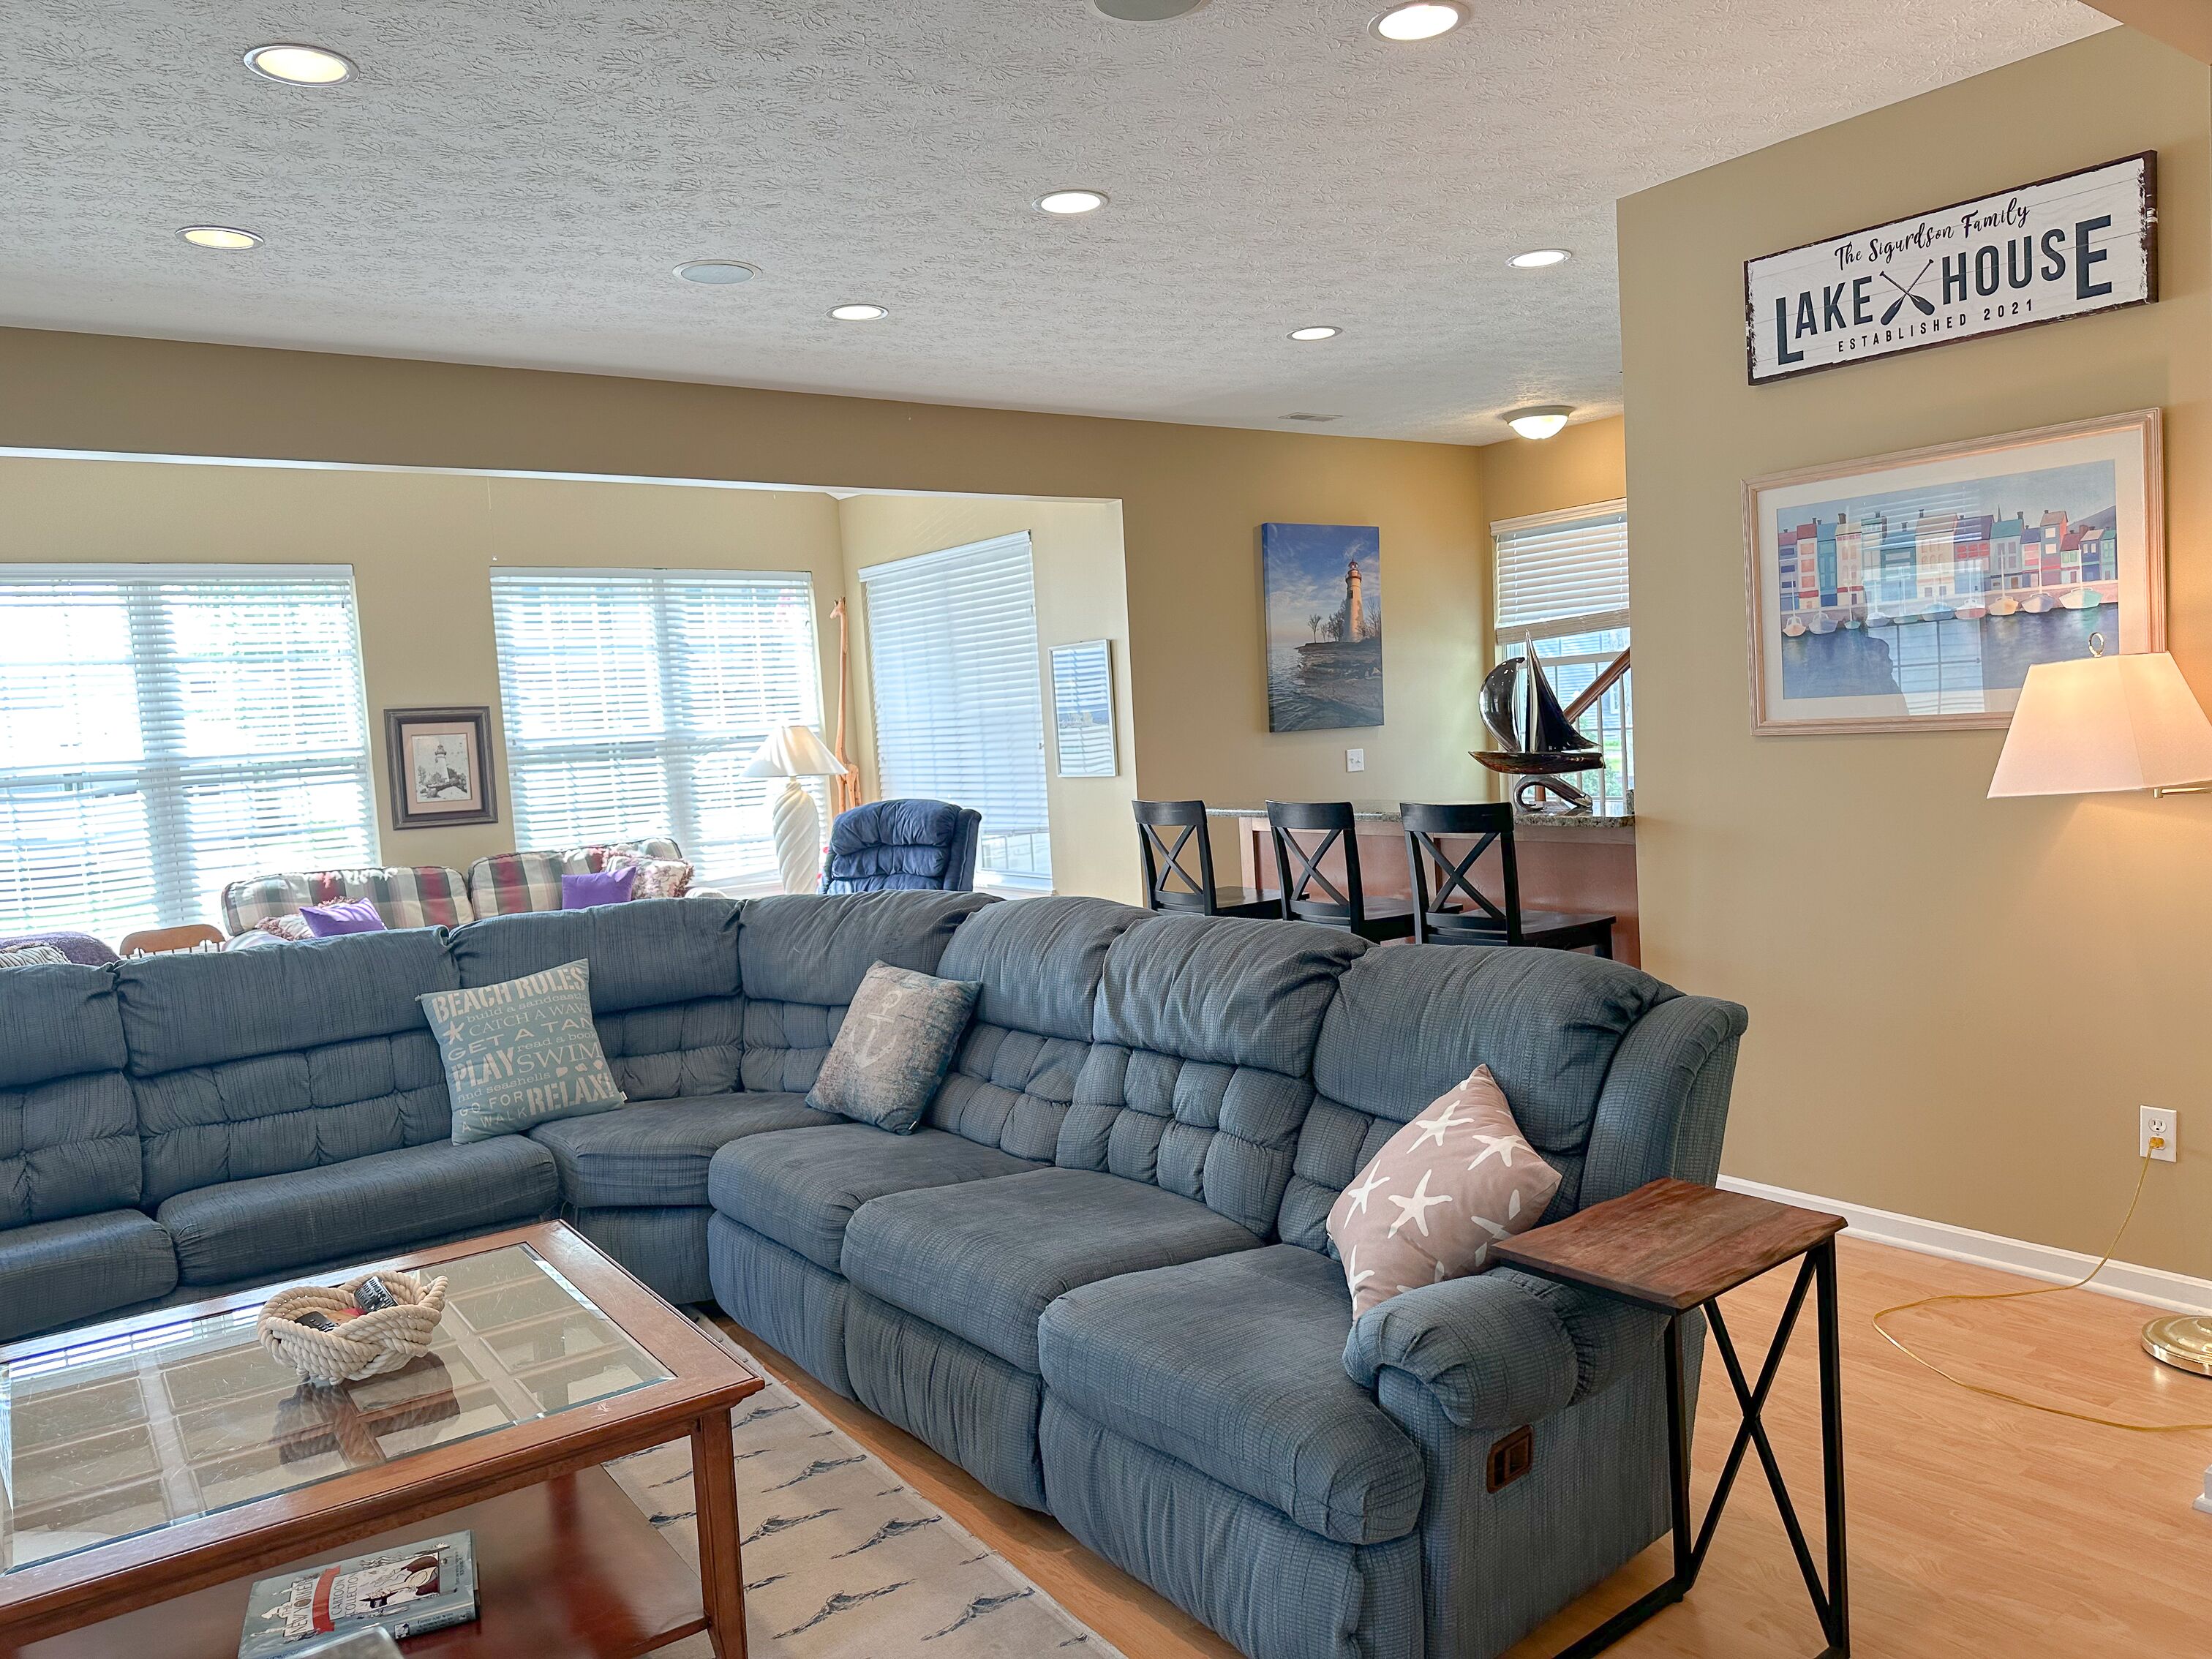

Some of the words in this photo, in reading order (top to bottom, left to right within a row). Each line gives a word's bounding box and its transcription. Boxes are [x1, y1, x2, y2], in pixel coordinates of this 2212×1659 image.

[1834, 245, 1862, 271] The
[1868, 222, 1954, 263] Sigurdson
[1961, 197, 2030, 239] Family
[1775, 275, 1873, 366] LAKE
[1941, 214, 2113, 305] HOUSE
[1837, 313, 1967, 353] ESTABLISHED
[1983, 298, 2033, 321] 2021
[432, 983, 512, 1023] BEACH
[514, 966, 586, 1000] RULES
[467, 1007, 503, 1023] build
[505, 1006, 516, 1014] a
[519, 993, 590, 1010] sandcastle
[448, 1034, 505, 1061] GET
[514, 1028, 535, 1042] A
[540, 1017, 595, 1033] TAN
[469, 1012, 530, 1037] CATCH
[534, 1009, 547, 1021] A
[516, 1037, 552, 1053] read
[567, 1030, 598, 1042] book
[451, 1047, 515, 1093] PLAY
[516, 1042, 603, 1074] SWIM
[486, 1071, 552, 1094] seashells
[459, 1102, 481, 1117] GO
[489, 1091, 524, 1110] FOR
[526, 1072, 614, 1116] RELAX!
[462, 1121, 472, 1133] A
[480, 1106, 527, 1129] WALK
[331, 1579, 345, 1616] CARTOON
[345, 1572, 358, 1616] COLLECTION
[289, 1614, 309, 1633] NEW
